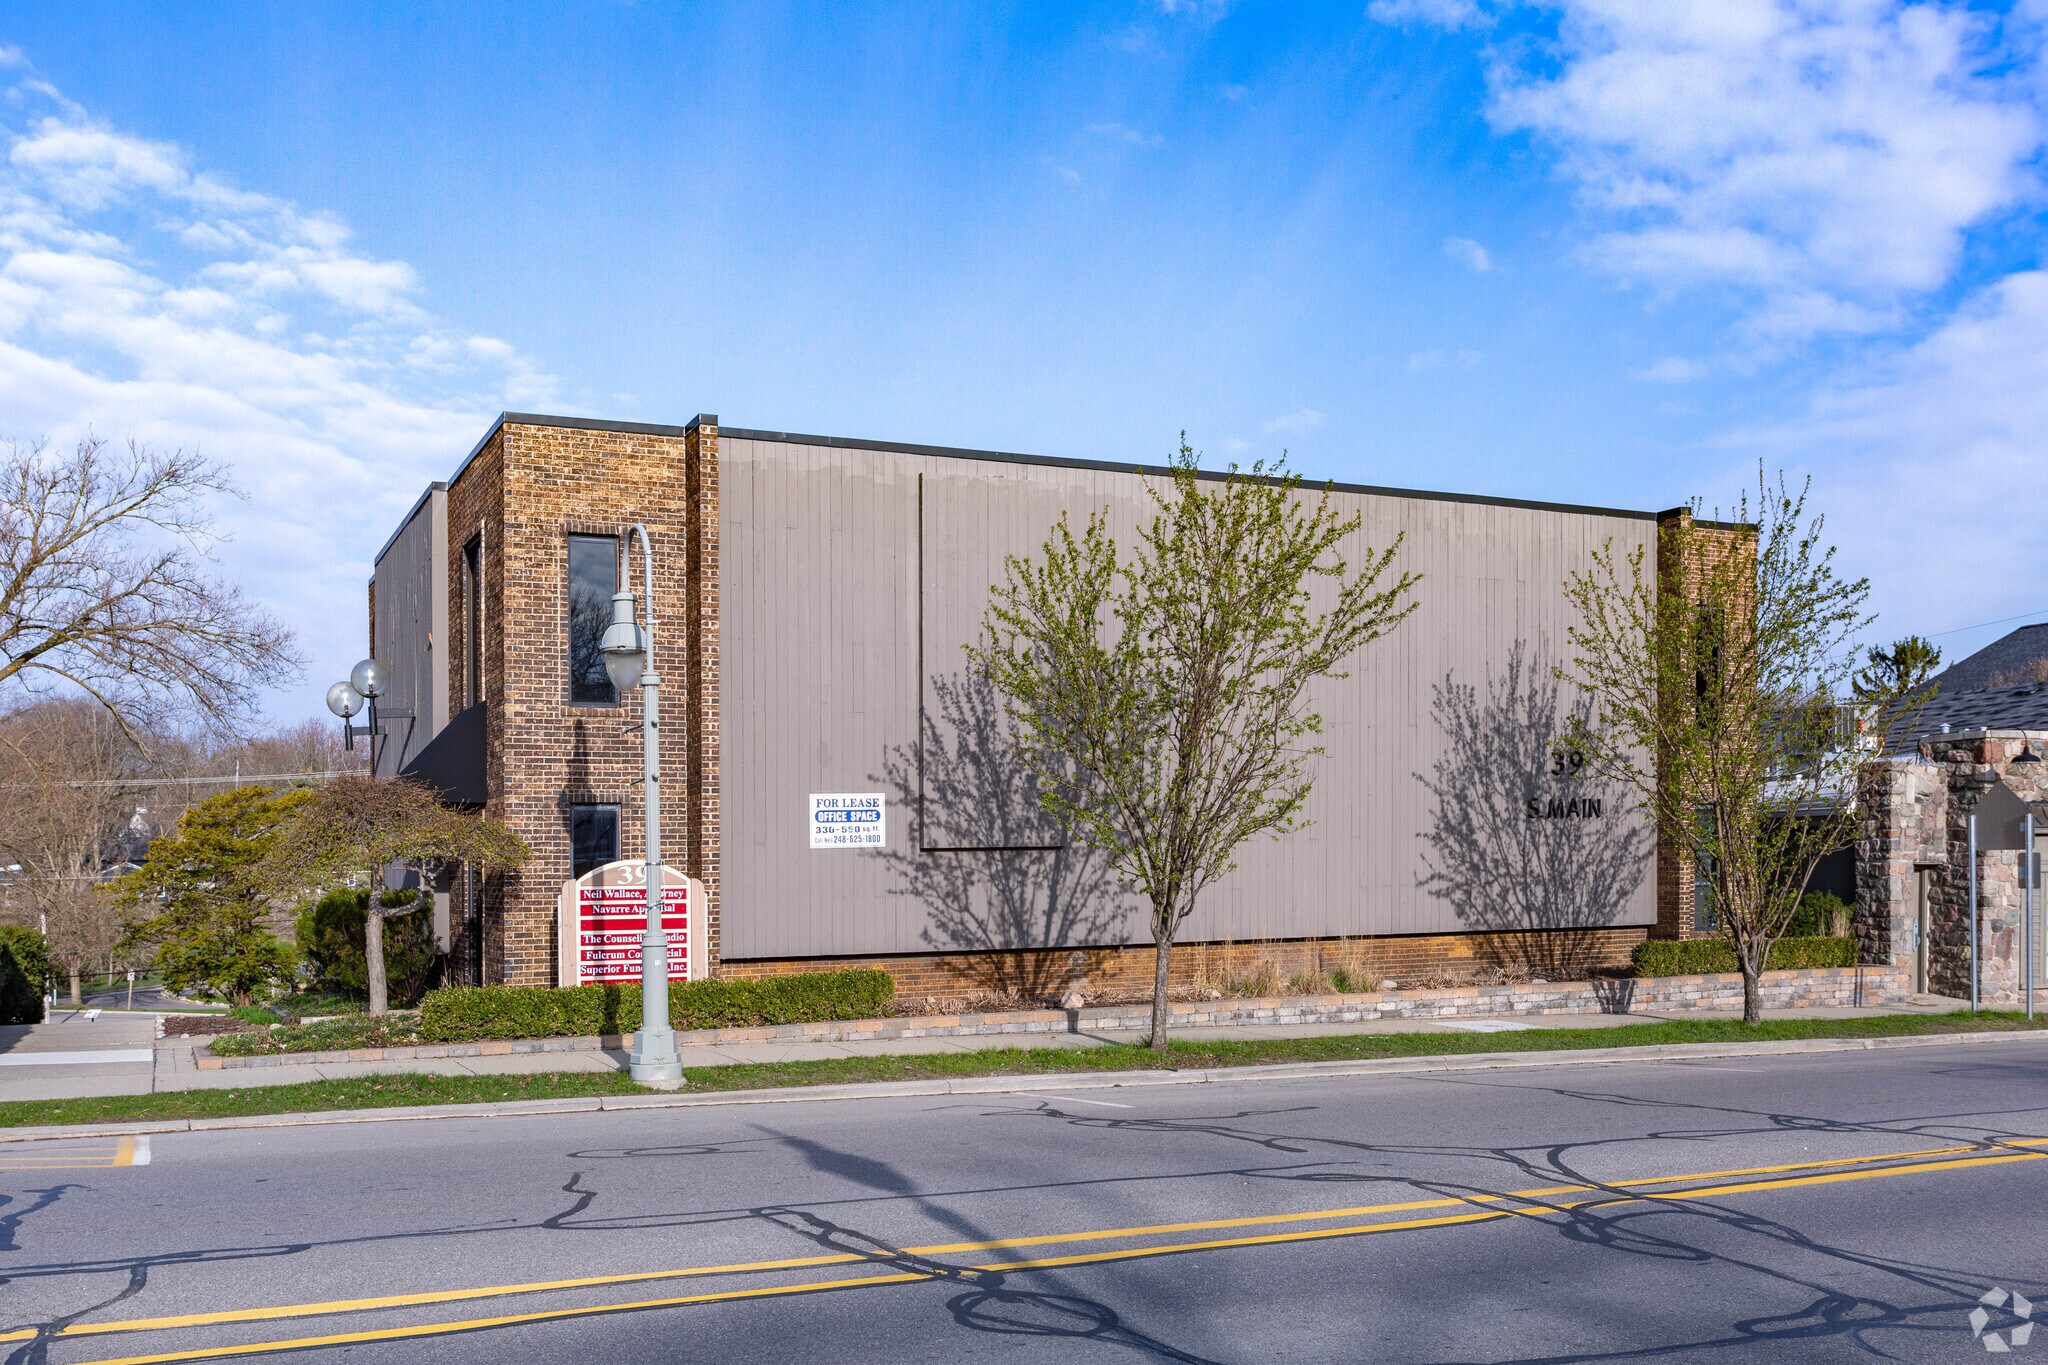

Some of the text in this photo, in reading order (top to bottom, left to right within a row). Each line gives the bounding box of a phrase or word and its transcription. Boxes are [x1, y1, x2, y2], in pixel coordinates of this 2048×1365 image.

[1551, 750, 1584, 776] 39
[816, 798, 880, 808] FOR LEASE
[817, 810, 878, 822] OFFICE SPACE
[583, 889, 603, 899] Neil
[604, 889, 643, 900] Wallace,
[592, 905, 630, 914] Navarre
[583, 933, 685, 944] The Counseli udio
[586, 948, 682, 960] Fulcrum Cocial
[580, 964, 621, 976] Superior
